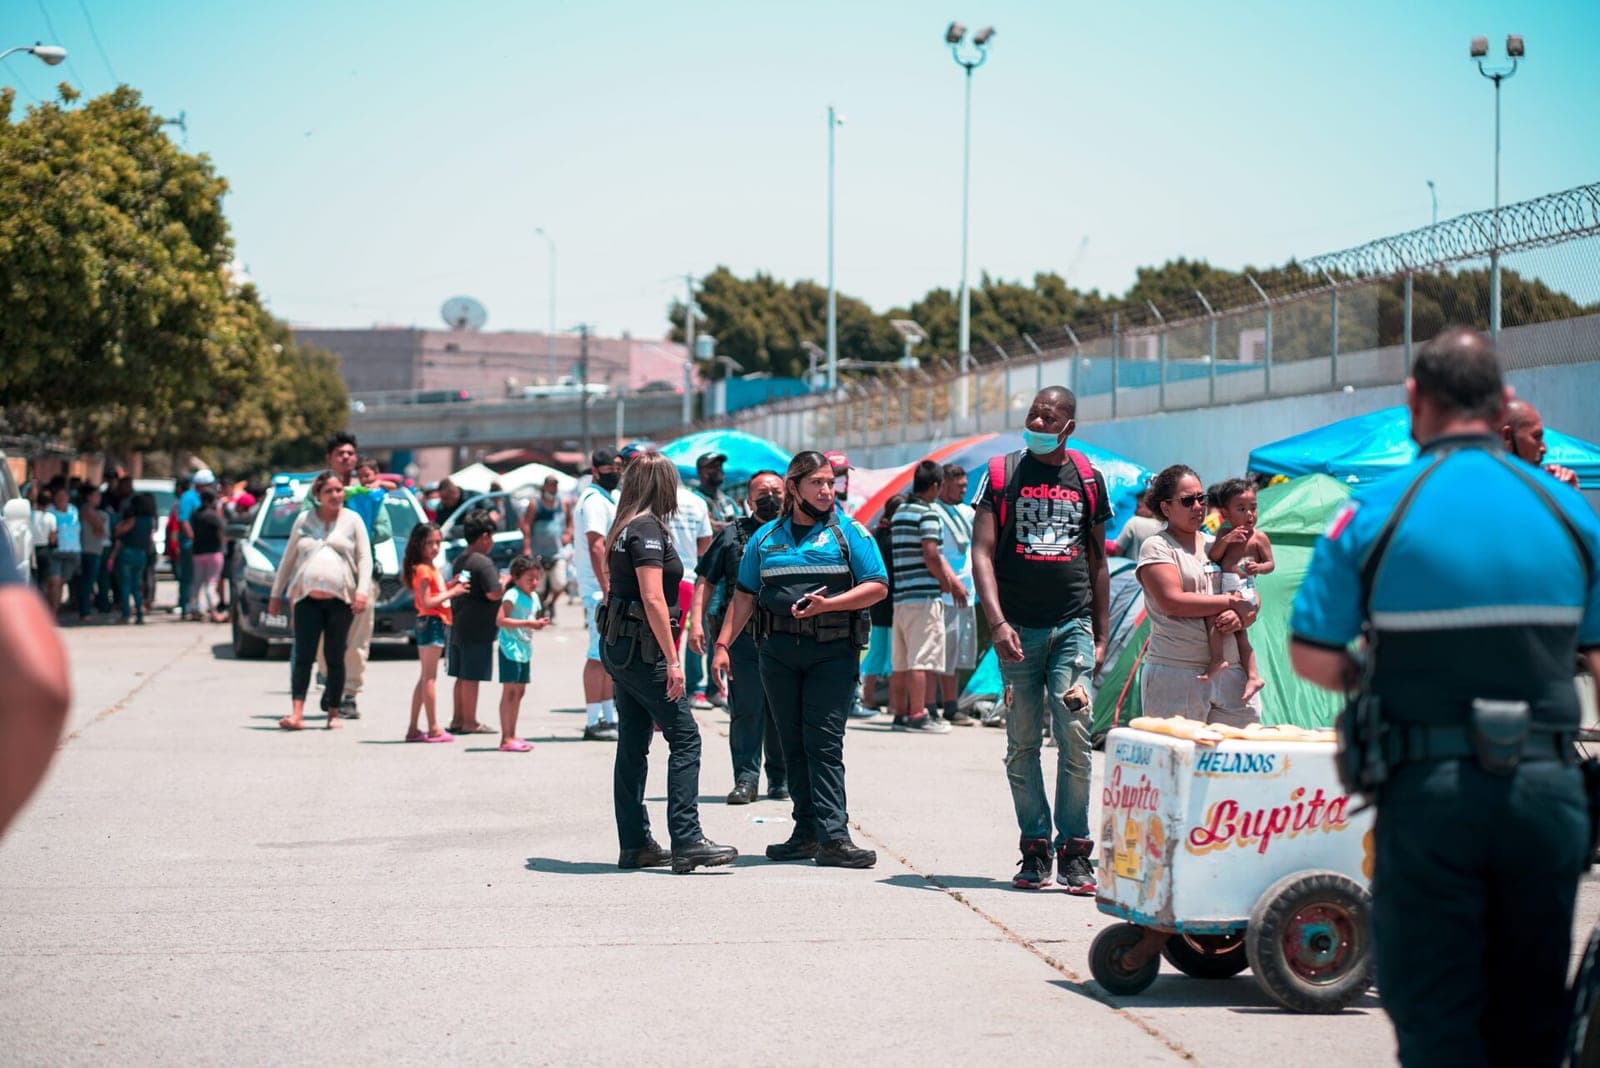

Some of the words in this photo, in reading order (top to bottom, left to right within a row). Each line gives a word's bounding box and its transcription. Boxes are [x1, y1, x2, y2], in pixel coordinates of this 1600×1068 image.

[1020, 484, 1080, 502] adidas
[1015, 497, 1083, 524] RUN
[1196, 751, 1276, 774] HELADOS
[1103, 764, 1159, 819] Lupita
[1188, 786, 1349, 855] Lupita
